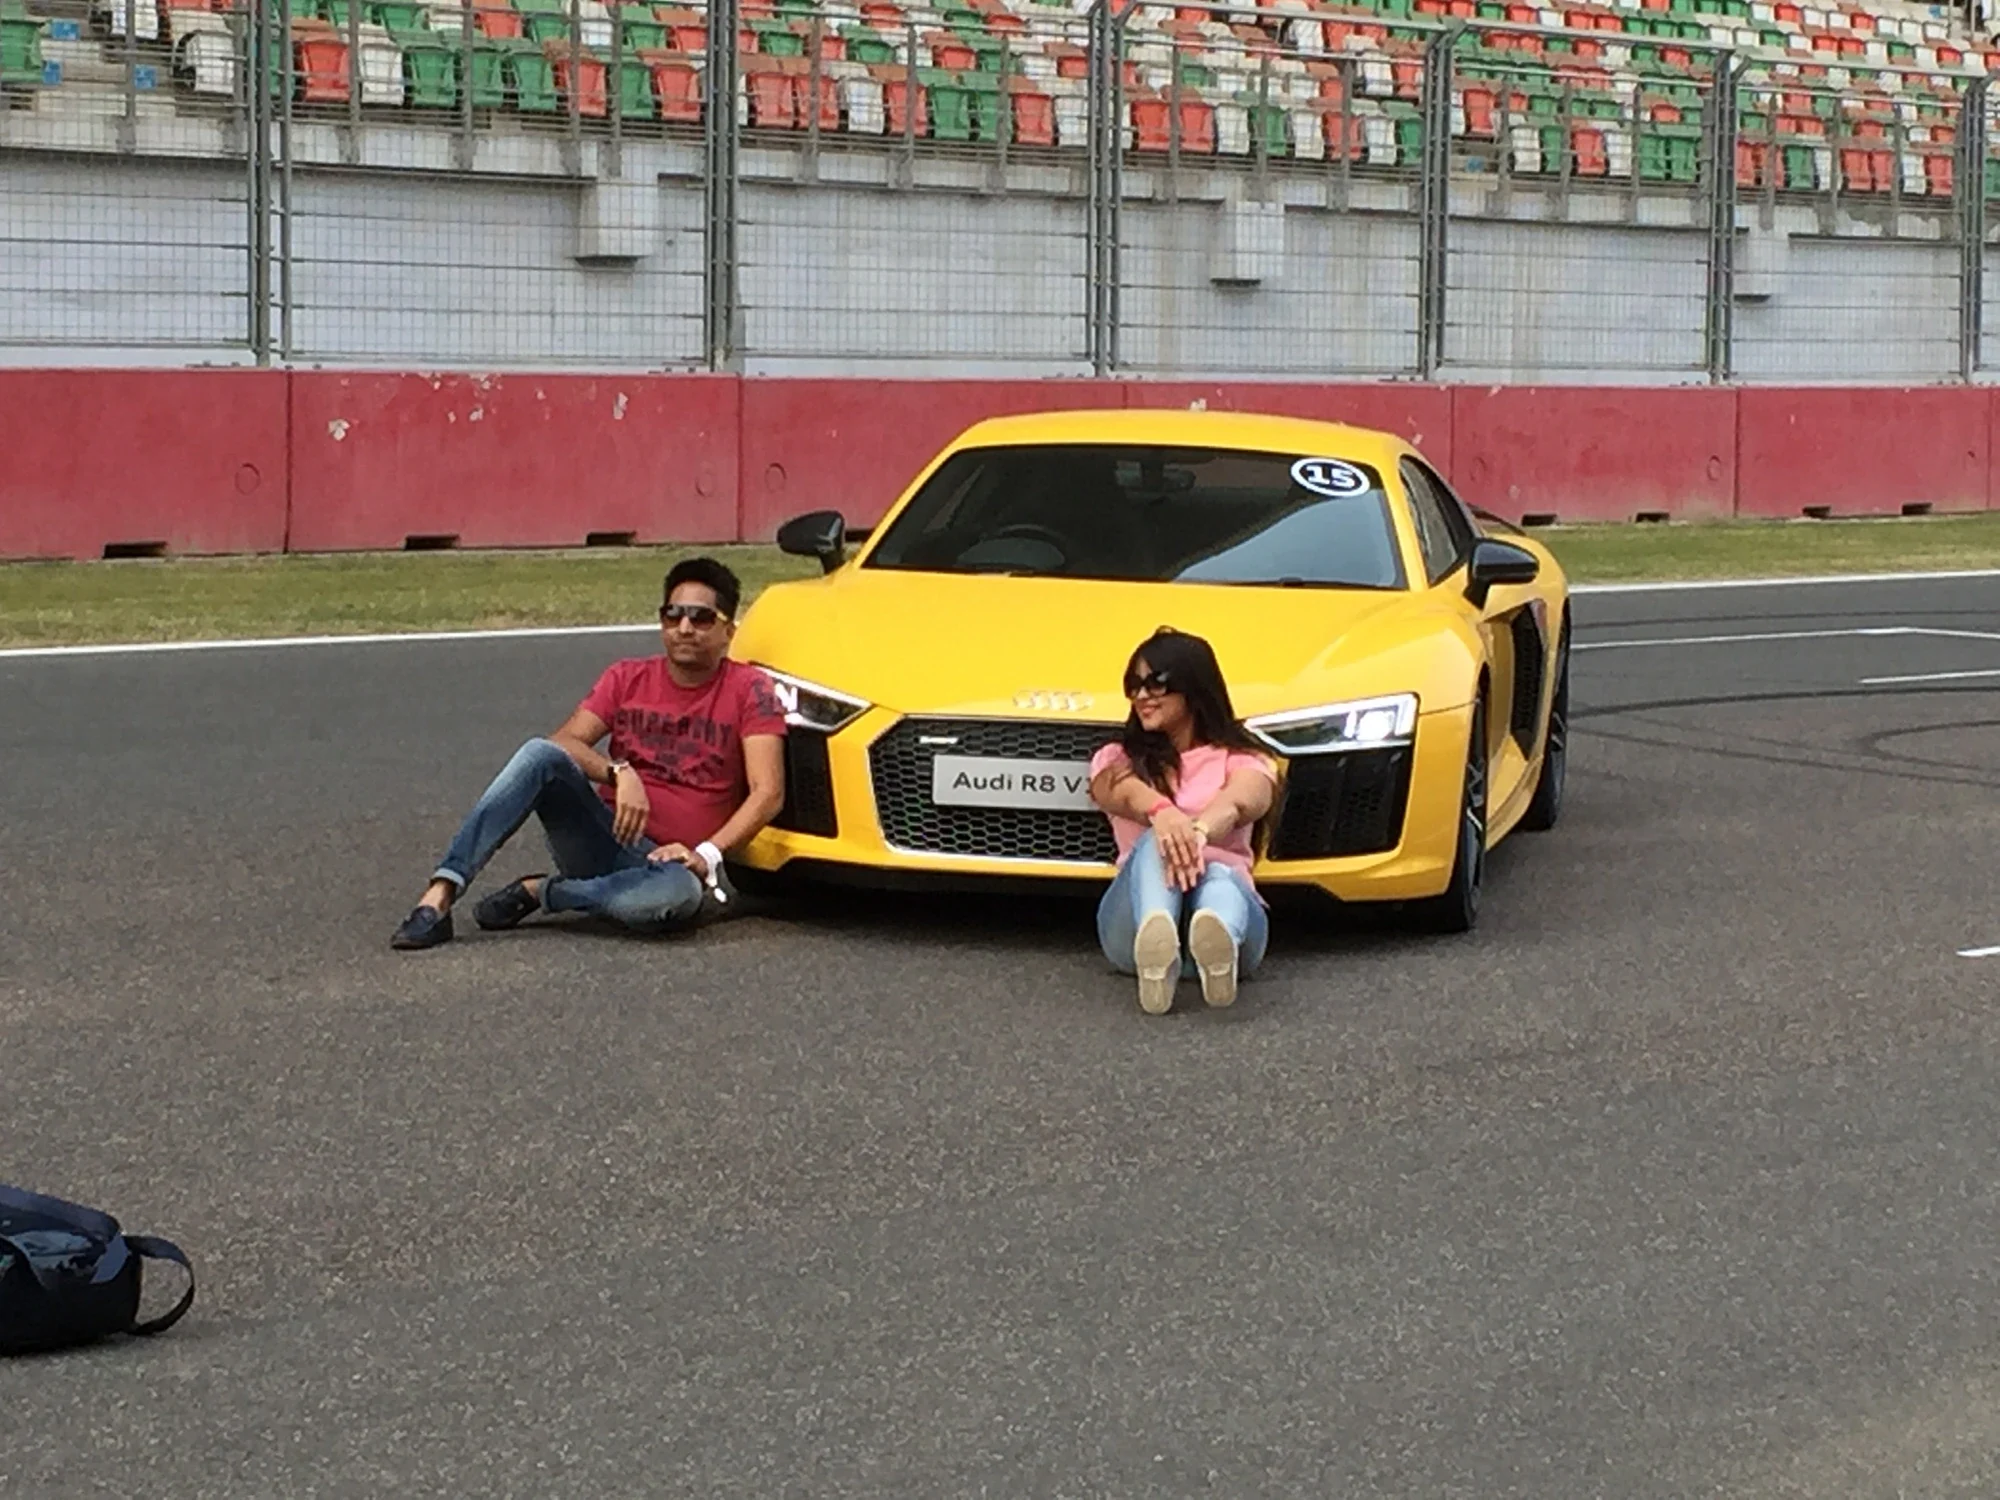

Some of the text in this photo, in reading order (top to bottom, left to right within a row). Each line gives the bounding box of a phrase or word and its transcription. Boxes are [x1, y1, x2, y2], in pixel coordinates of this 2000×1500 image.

[1306, 465, 1355, 488] 15
[952, 772, 1092, 794] Audi R8 V
